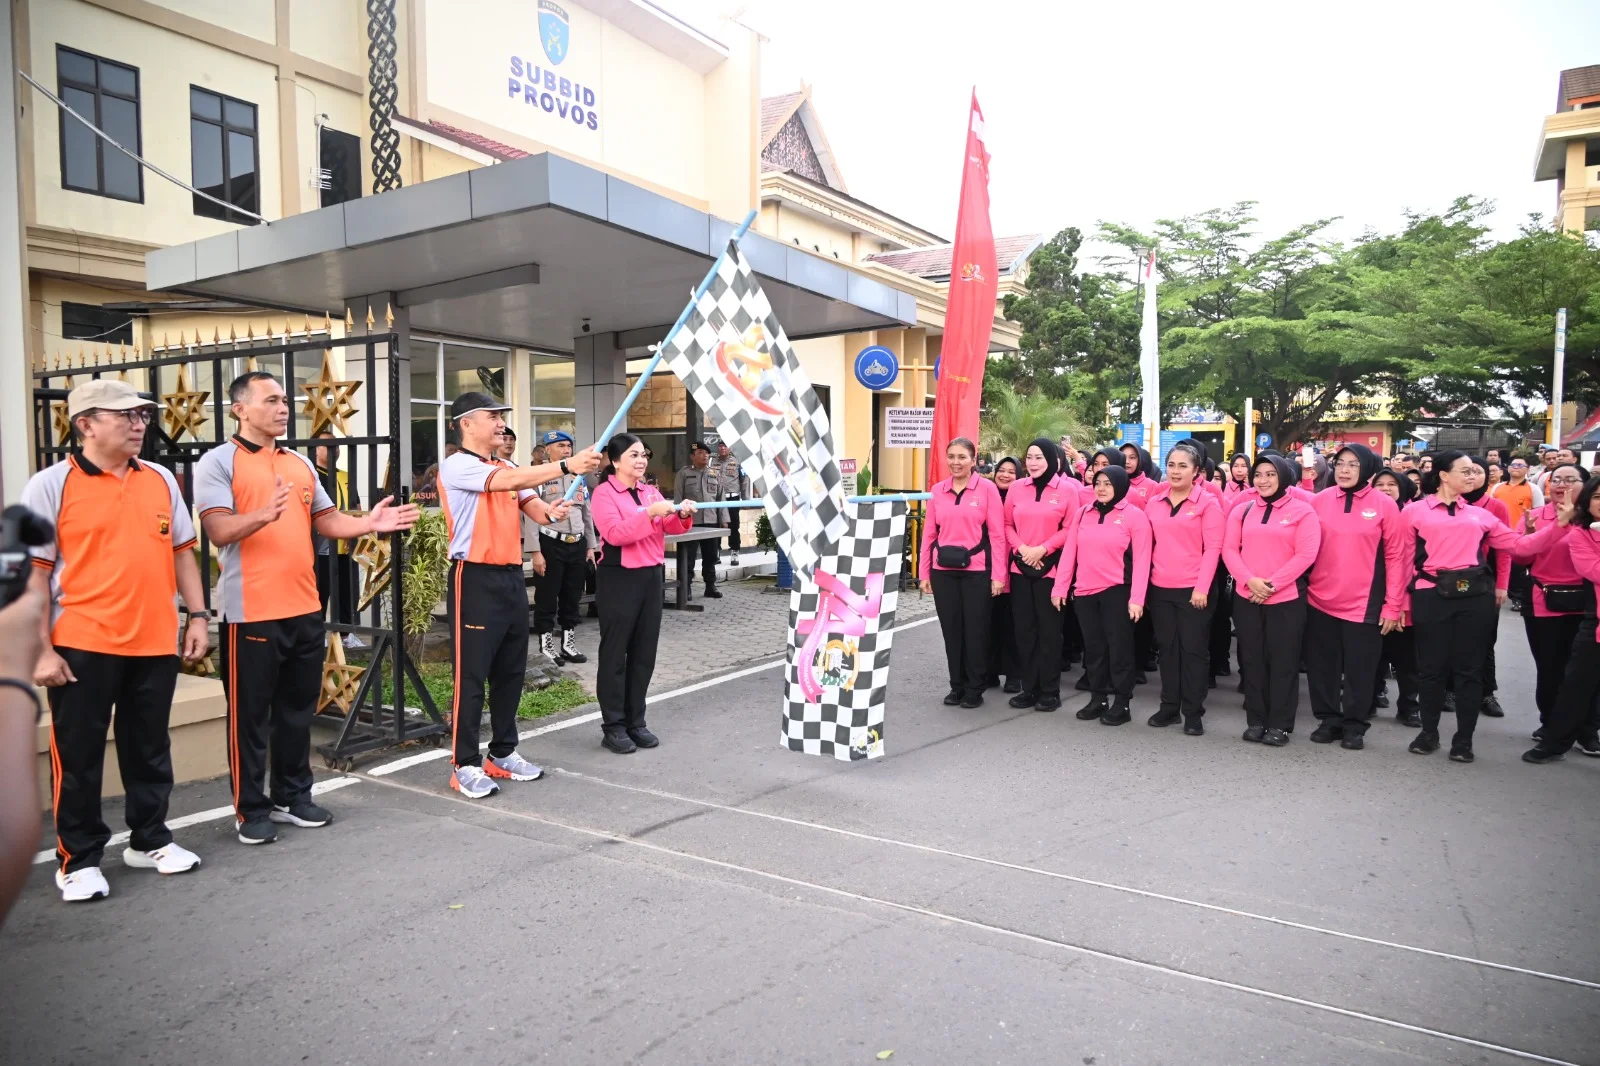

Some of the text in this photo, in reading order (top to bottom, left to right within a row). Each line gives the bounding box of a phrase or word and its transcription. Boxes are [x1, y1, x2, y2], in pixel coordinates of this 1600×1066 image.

[510, 56, 595, 107] SUBBID
[508, 77, 598, 131] PROVOS
[1333, 403, 1382, 411] COMPETENCY
[1259, 435, 1269, 446] P
[414, 492, 437, 500] ASUK
